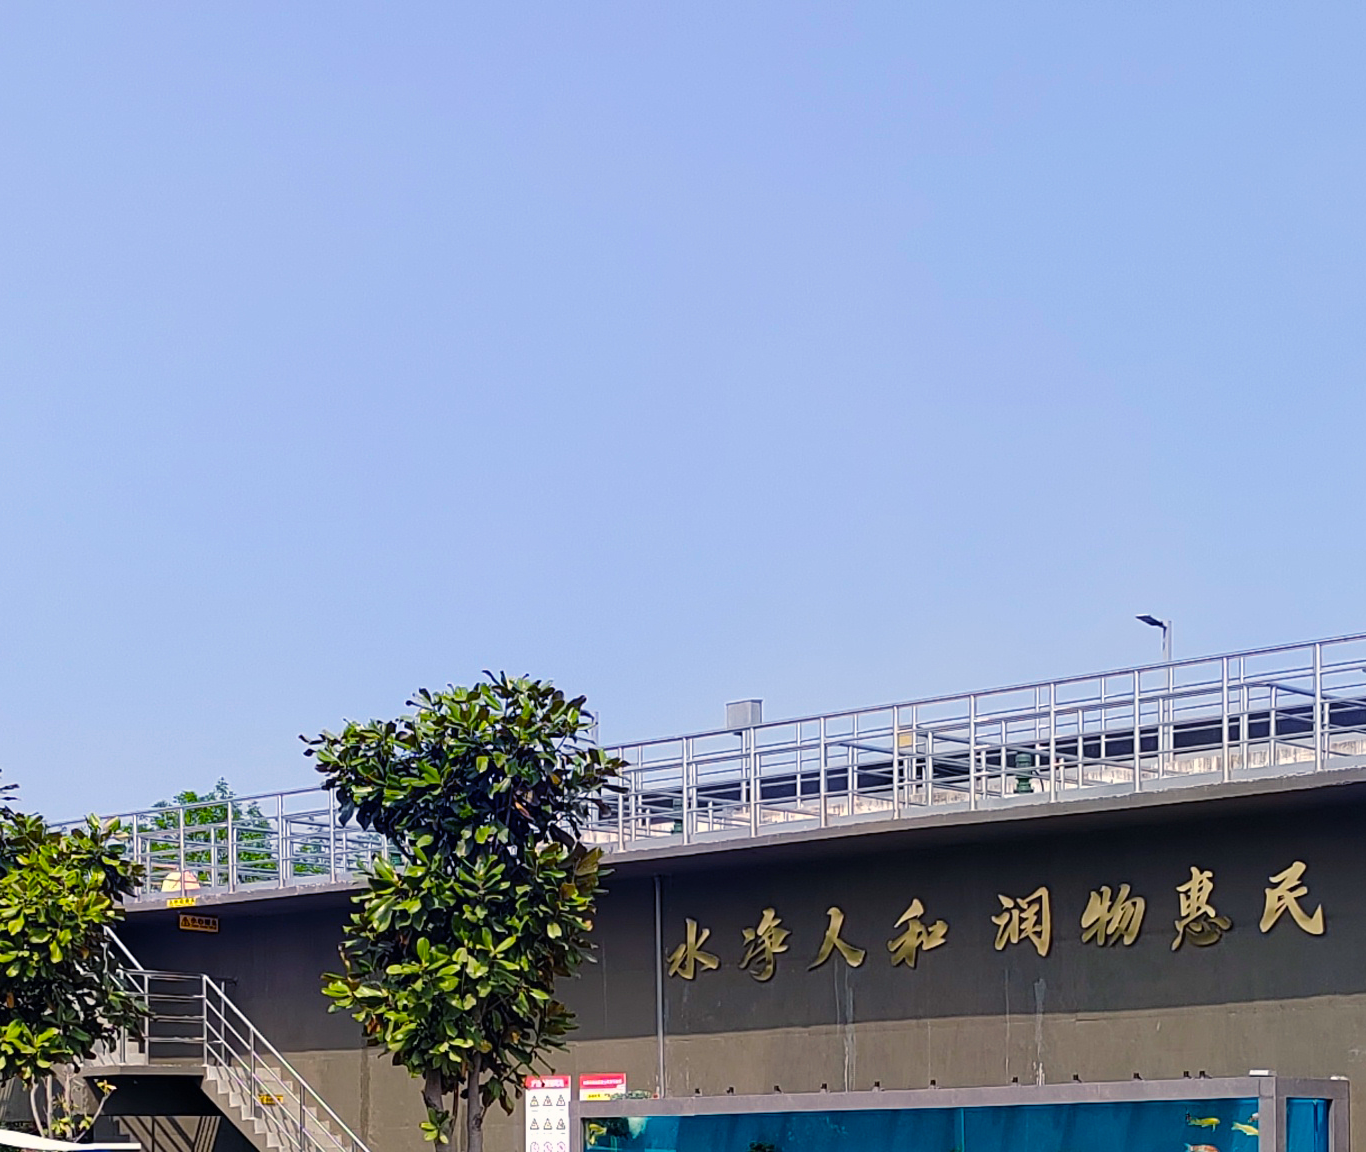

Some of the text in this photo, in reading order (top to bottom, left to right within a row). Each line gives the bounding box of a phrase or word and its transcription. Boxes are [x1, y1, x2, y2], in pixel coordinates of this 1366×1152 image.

[666, 860, 1327, 982] 水净人和 润物惠民
